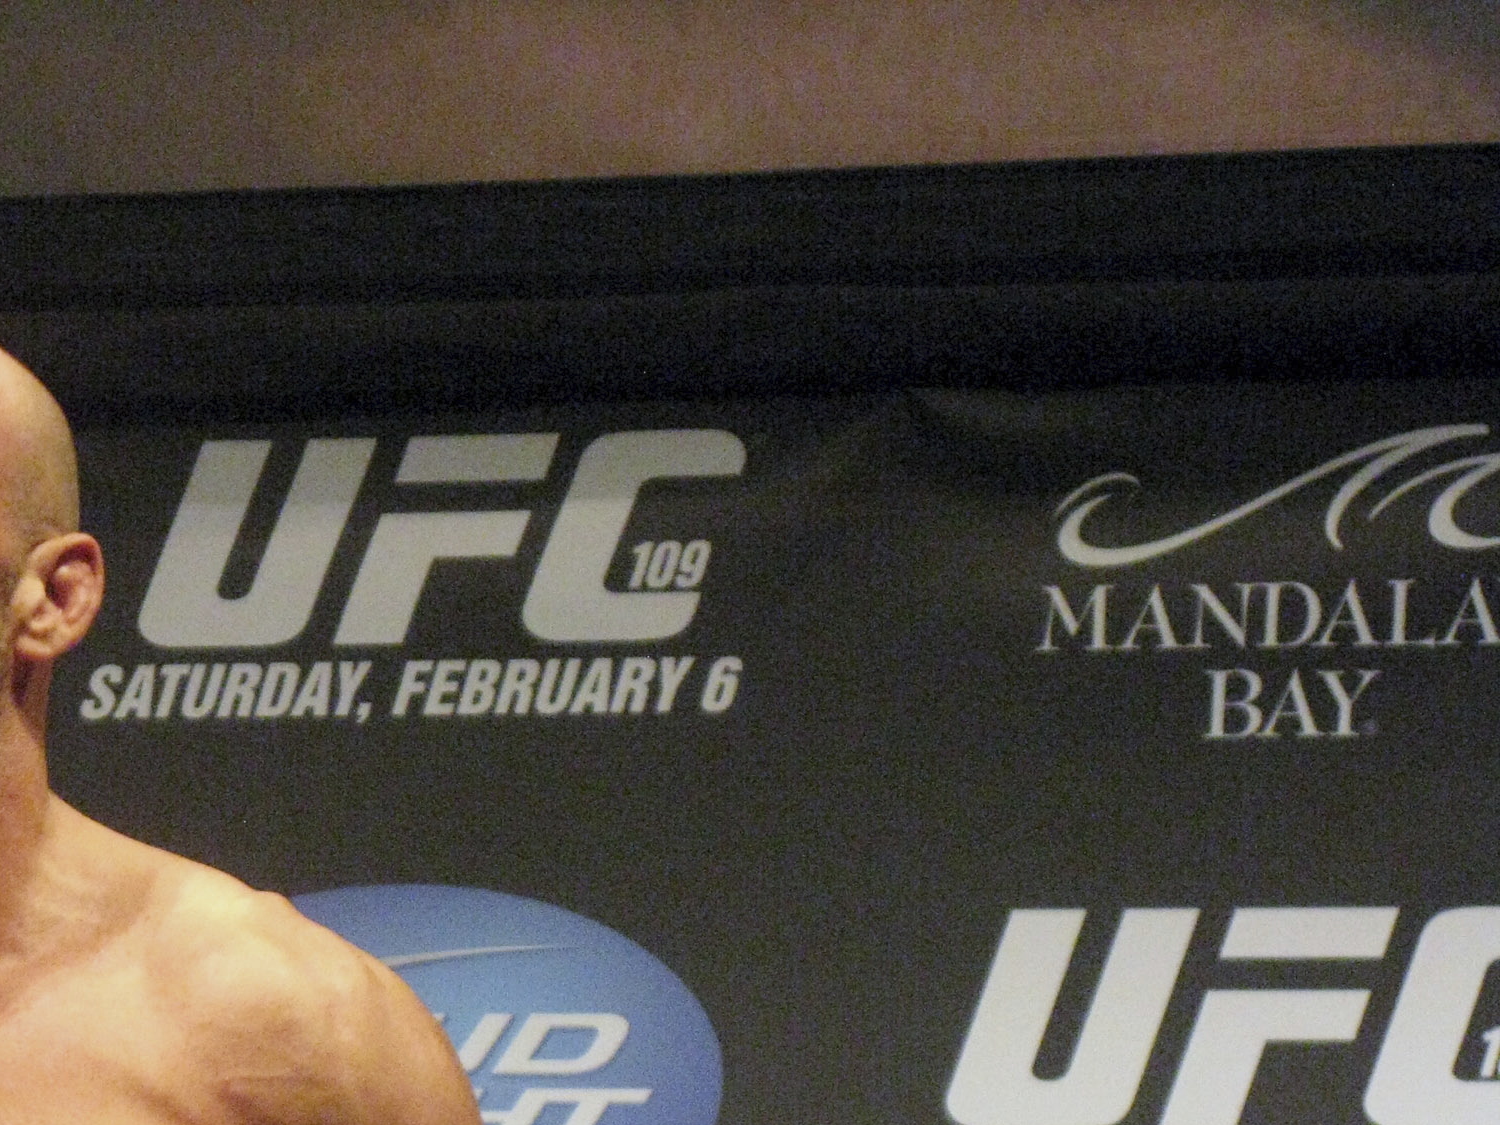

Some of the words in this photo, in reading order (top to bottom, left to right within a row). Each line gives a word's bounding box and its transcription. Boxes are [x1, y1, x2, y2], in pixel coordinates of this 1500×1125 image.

[138, 429, 747, 646] UFC
[627, 539, 711, 588] 109
[1036, 577, 1500, 652] MANDALA
[80, 662, 376, 722] SATURDAY,
[391, 656, 694, 716] FEBRUARY
[701, 656, 743, 712] 6
[1205, 668, 1380, 740] BAY
